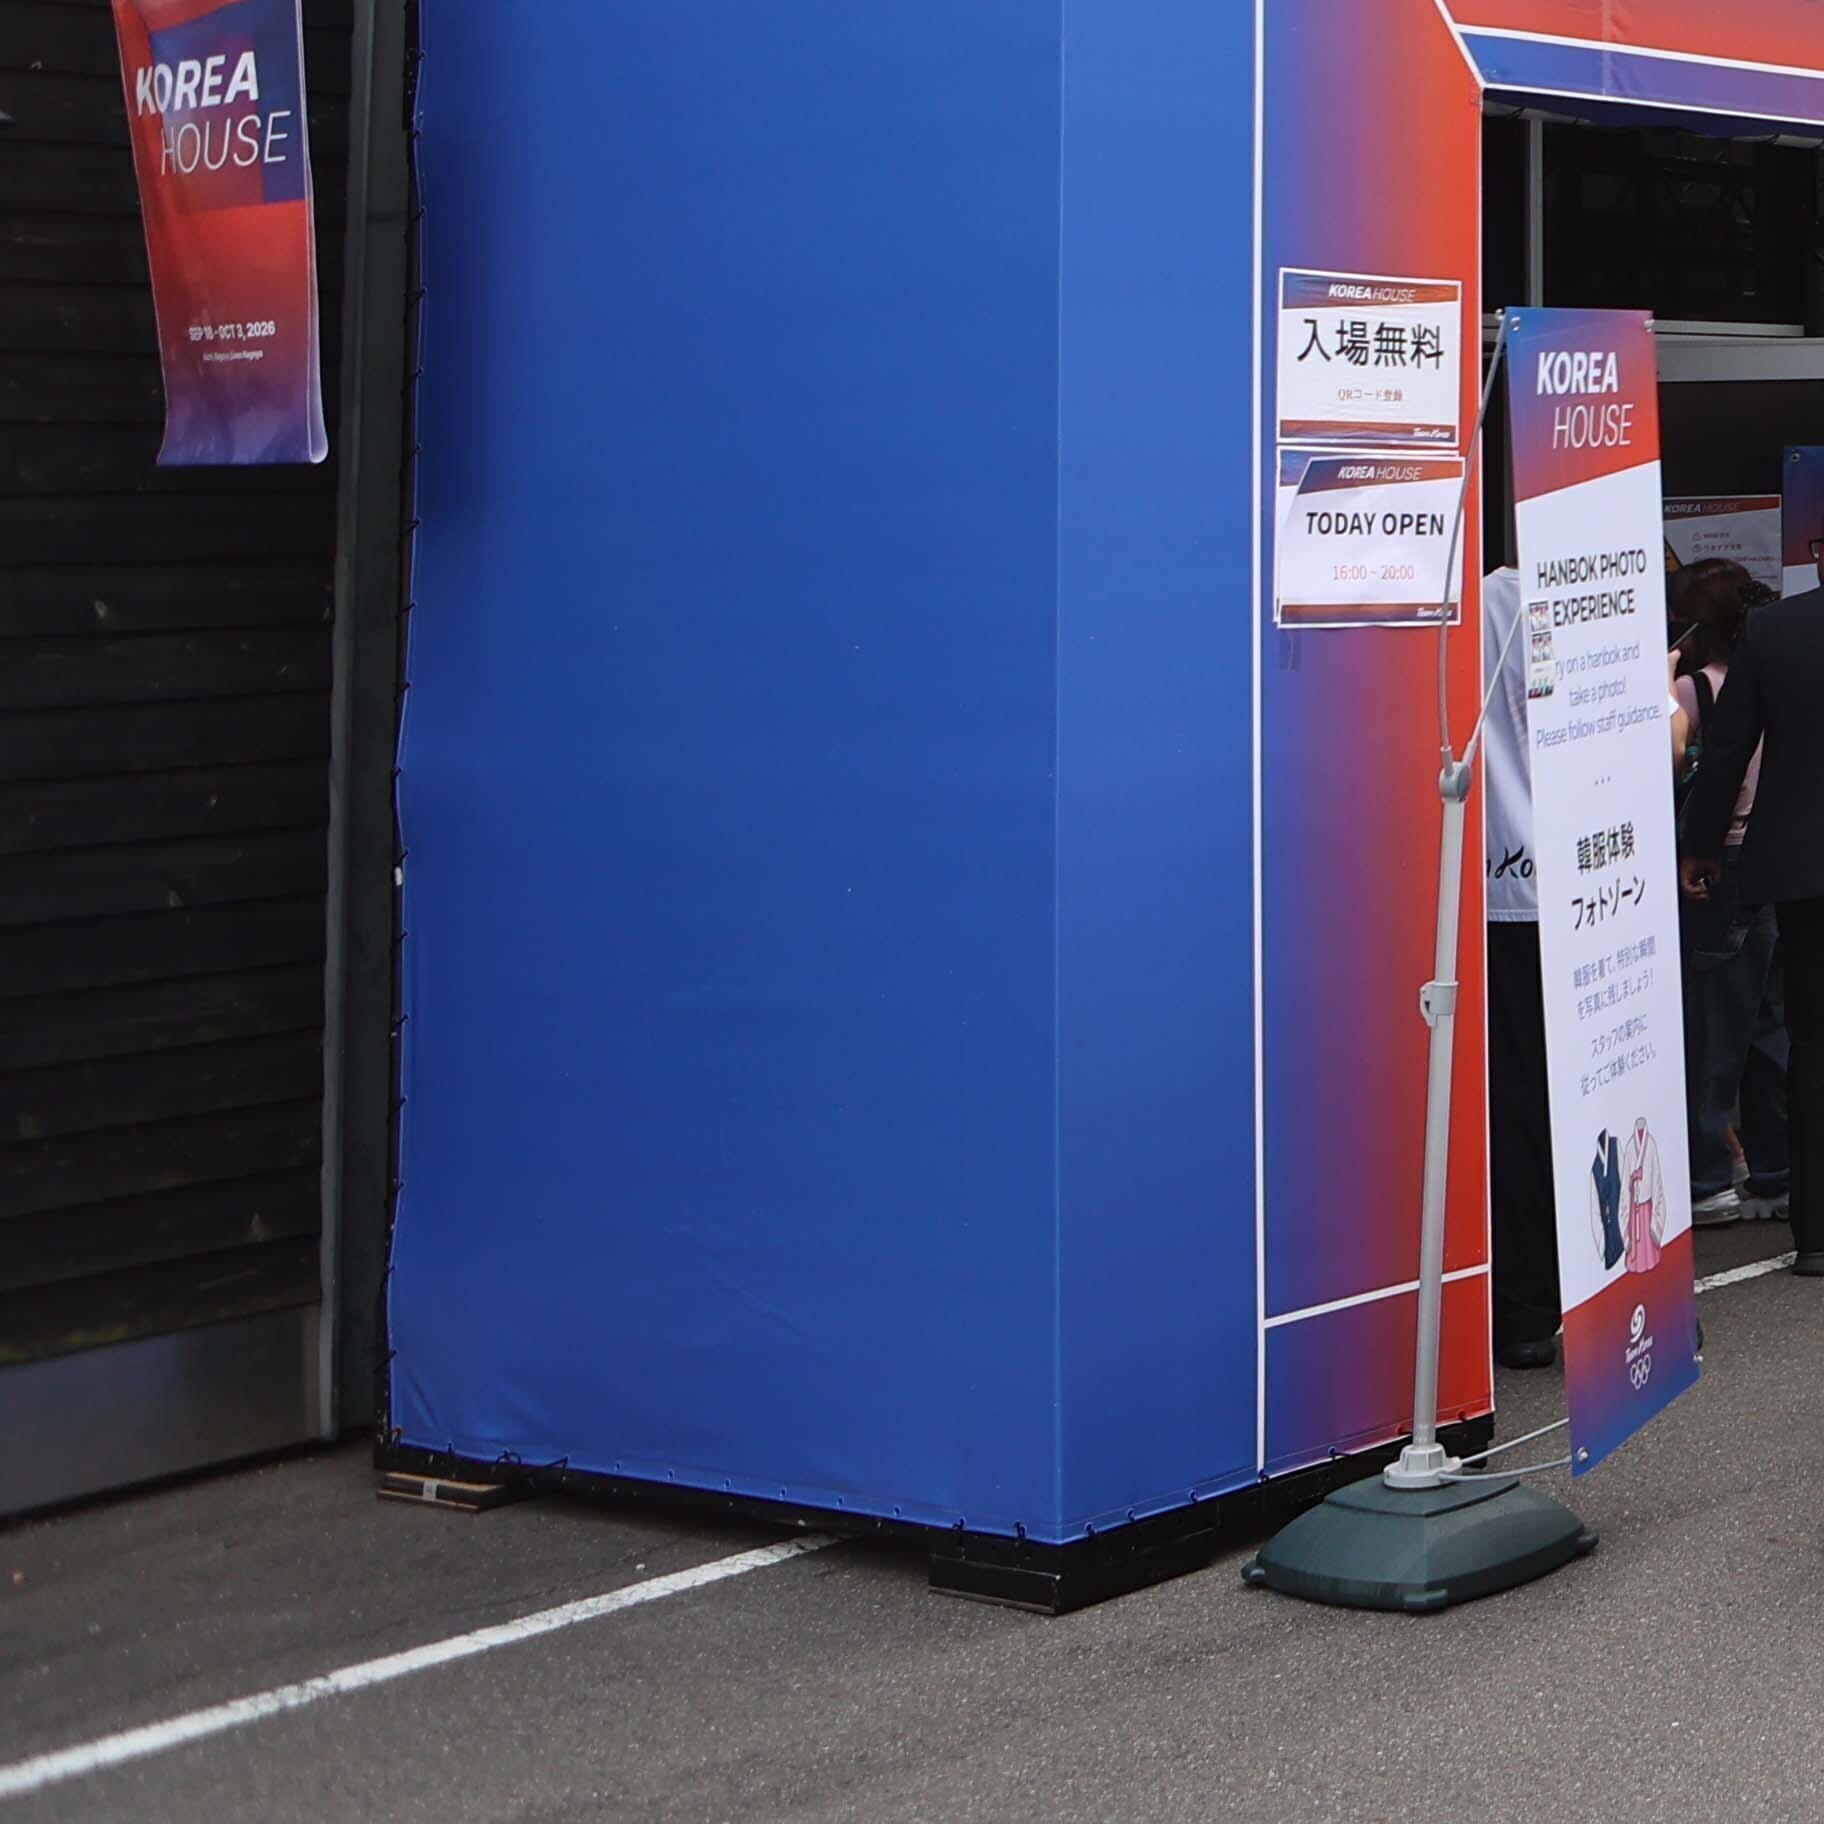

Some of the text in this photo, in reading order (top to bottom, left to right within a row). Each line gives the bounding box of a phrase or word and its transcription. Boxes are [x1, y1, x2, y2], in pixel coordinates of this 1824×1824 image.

[136, 50, 259, 116] KOREA
[159, 109, 292, 177] HOUSE
[1328, 283, 1416, 303] KOREA HOUSE
[246, 319, 276, 338] 2026
[1297, 318, 1445, 370] 入場無料
[1536, 351, 1620, 395] KOREA
[1552, 403, 1635, 450] HOUSE
[1337, 465, 1422, 482] KOREA HOUSE
[1306, 511, 1445, 537] TODAY OPEN
[1332, 563, 1367, 581] 16:00
[1381, 564, 1415, 581] 20:00
[1537, 548, 1647, 589] HANBOK PHOTO
[1553, 588, 1636, 628] EXPERIENCE
[1576, 821, 1635, 876] 韓服体験
[1571, 875, 1646, 931] フォトゾーン
